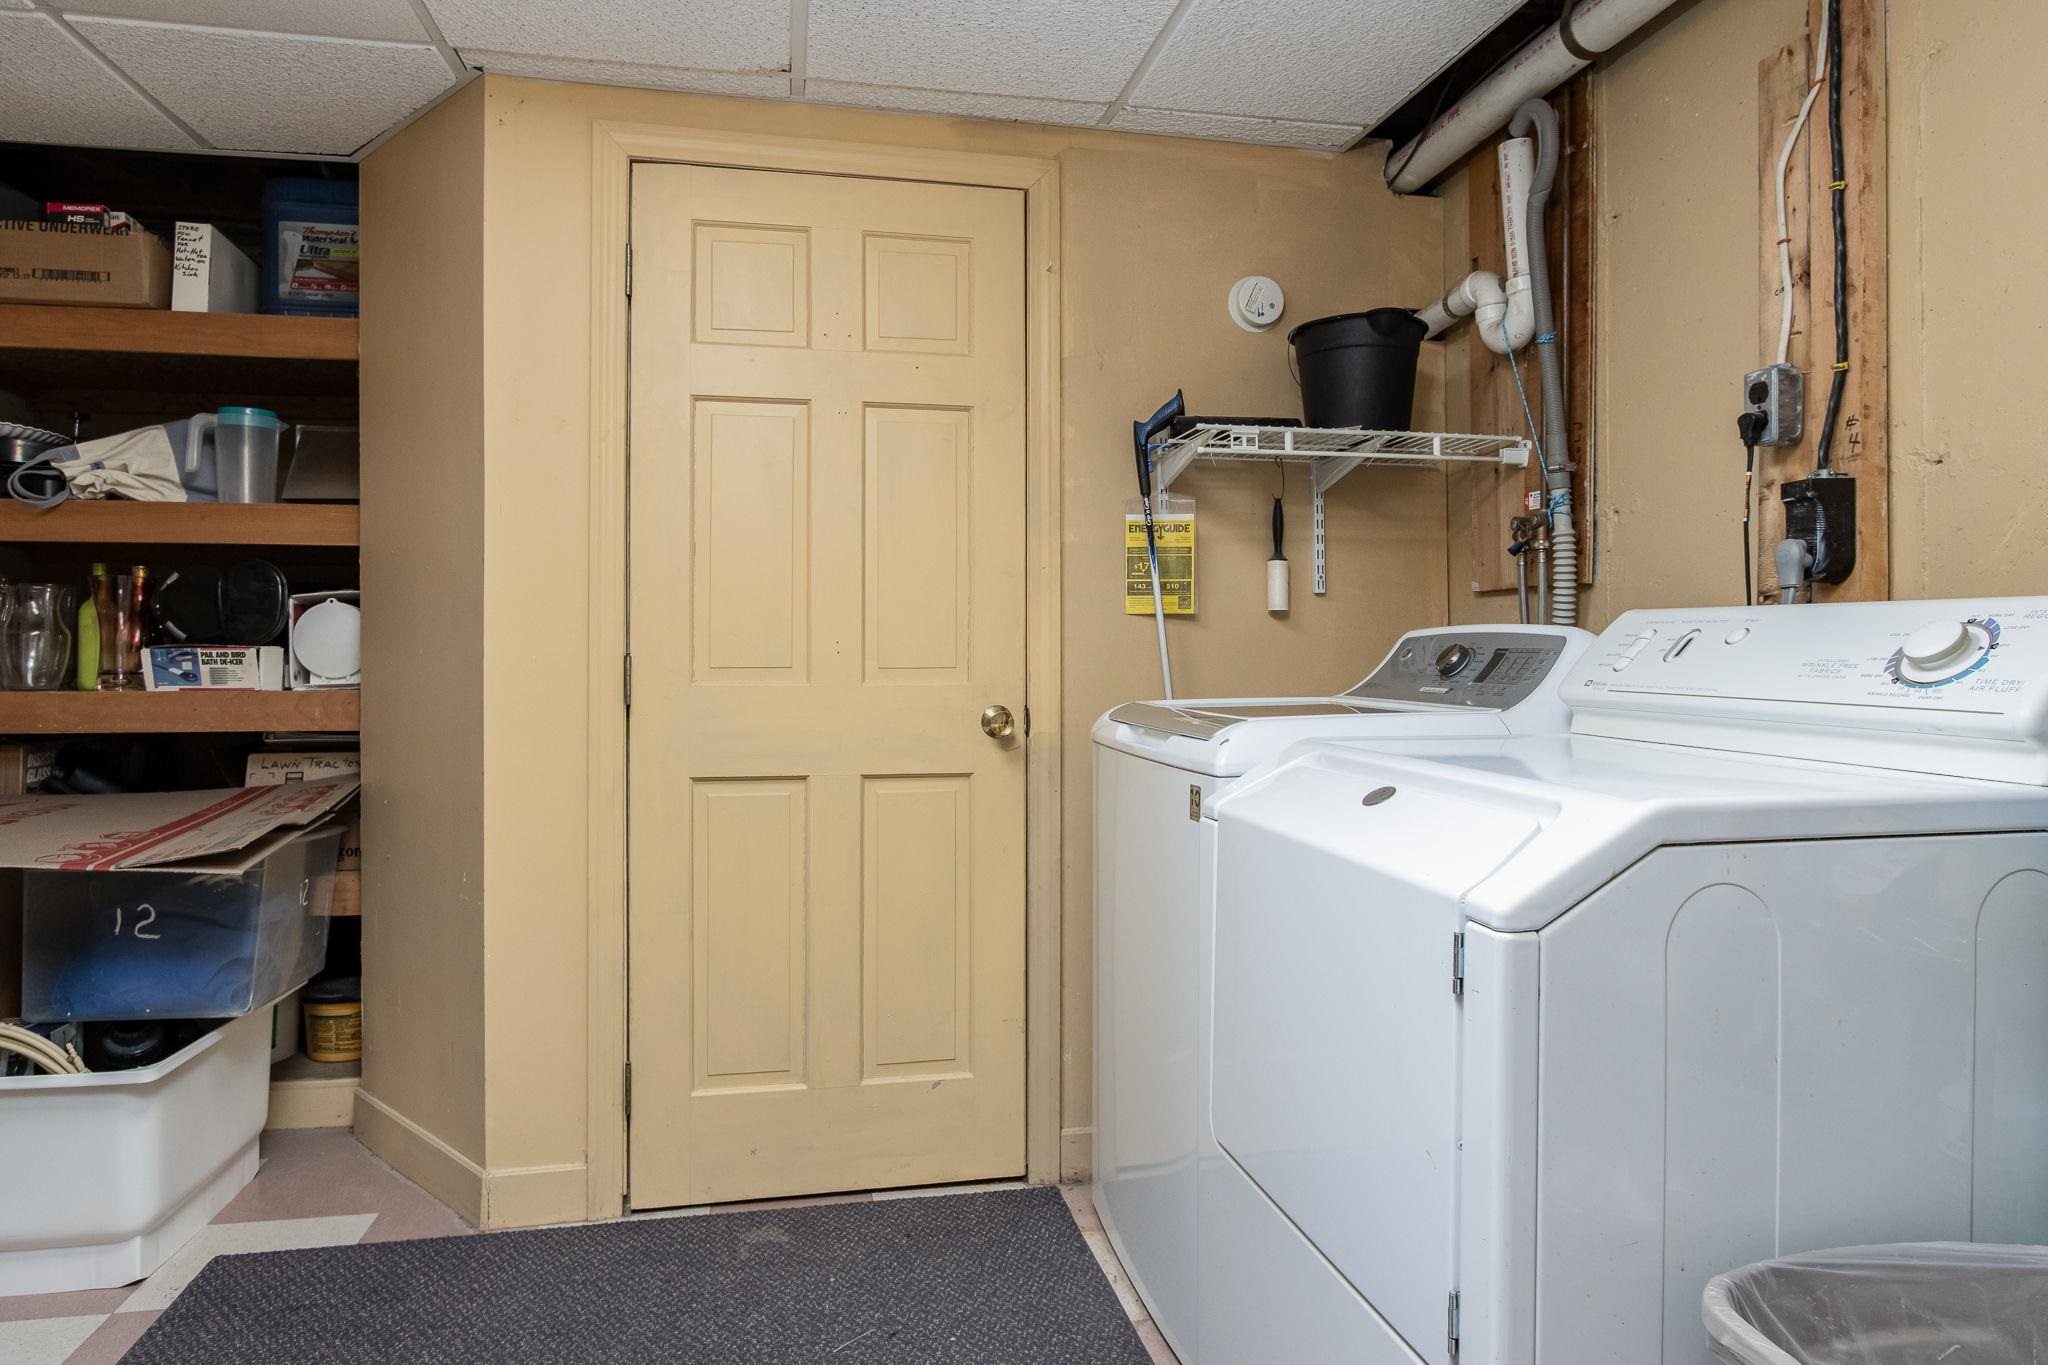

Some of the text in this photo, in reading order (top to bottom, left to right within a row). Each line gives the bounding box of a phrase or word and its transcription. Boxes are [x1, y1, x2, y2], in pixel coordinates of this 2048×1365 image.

[67, 214, 85, 223] HS
[0, 219, 34, 231] TIVE
[299, 244, 330, 256] Ultra
[1849, 432, 1860, 453] 4
[1128, 523, 1191, 533] ENEGYGUIDE
[1975, 678, 2000, 686] TIME
[261, 757, 301, 769] LAWN
[114, 903, 161, 940] 12
